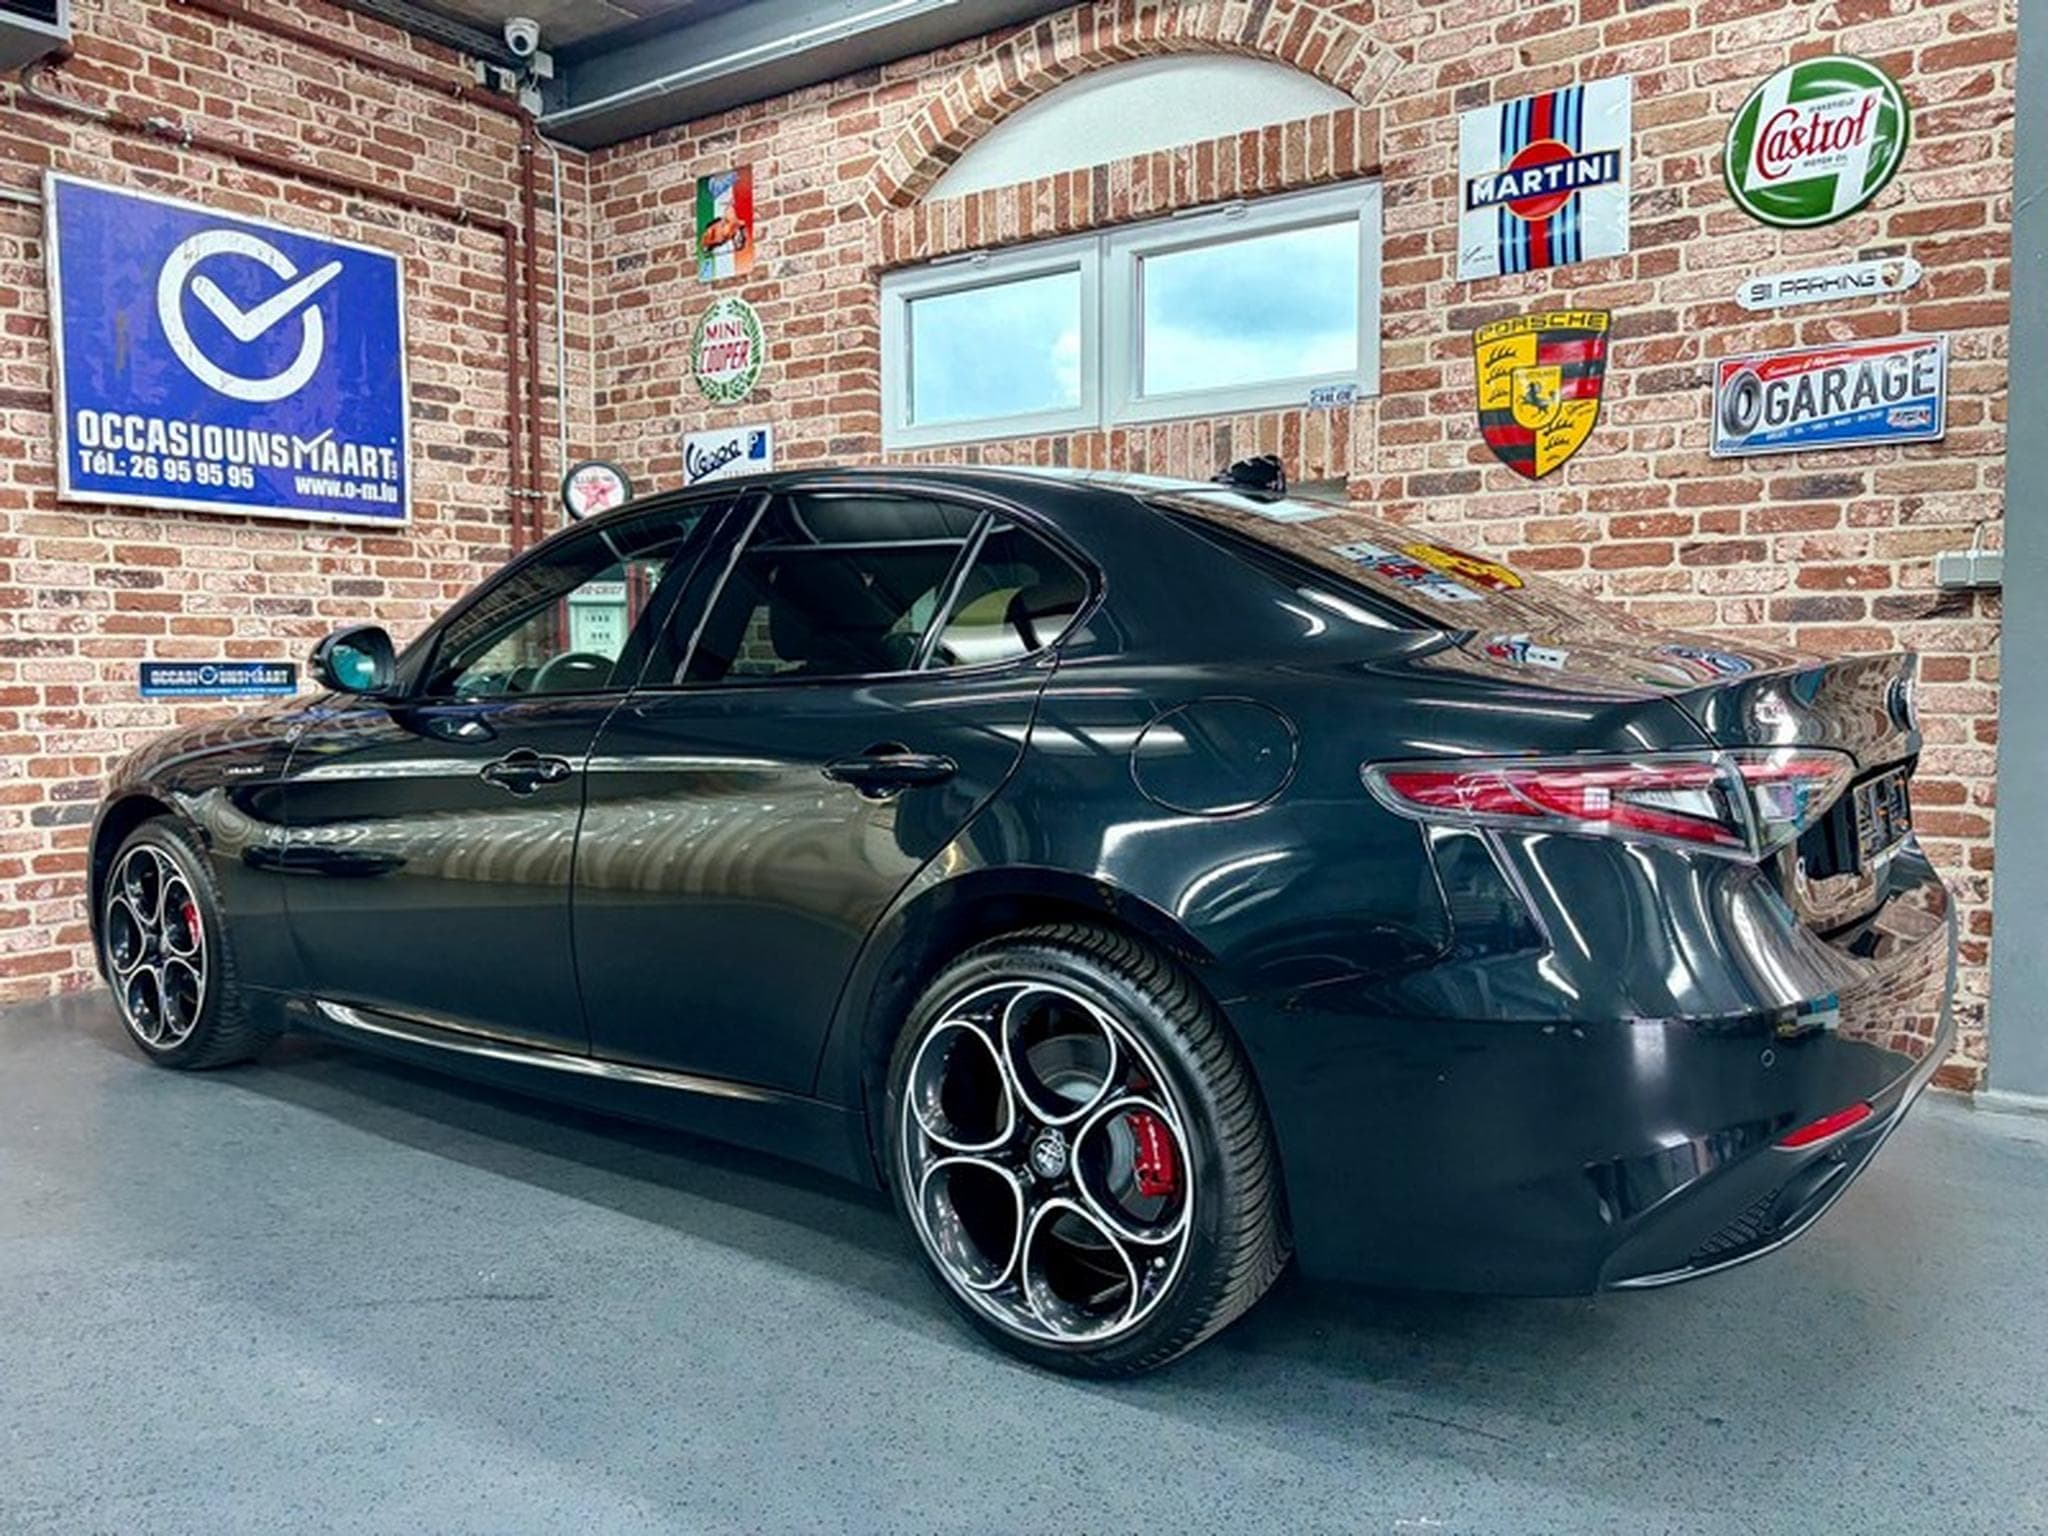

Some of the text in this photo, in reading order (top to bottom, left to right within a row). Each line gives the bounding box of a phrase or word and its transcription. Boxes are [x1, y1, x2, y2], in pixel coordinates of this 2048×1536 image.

[1756, 95, 1877, 181] Castrol
[1471, 154, 1613, 206] MARTINI
[1779, 268, 1877, 297] PARKING
[705, 320, 741, 341] MINI
[1478, 313, 1604, 342] PORSCHE
[701, 340, 750, 374] COOPER
[1764, 348, 1937, 427] GARAGE
[130, 455, 159, 480] 26
[163, 458, 192, 484] 95
[196, 462, 226, 487] 95
[227, 465, 255, 489] 95
[686, 440, 742, 484] Vespa
[294, 476, 398, 503] www.o-m.lu
